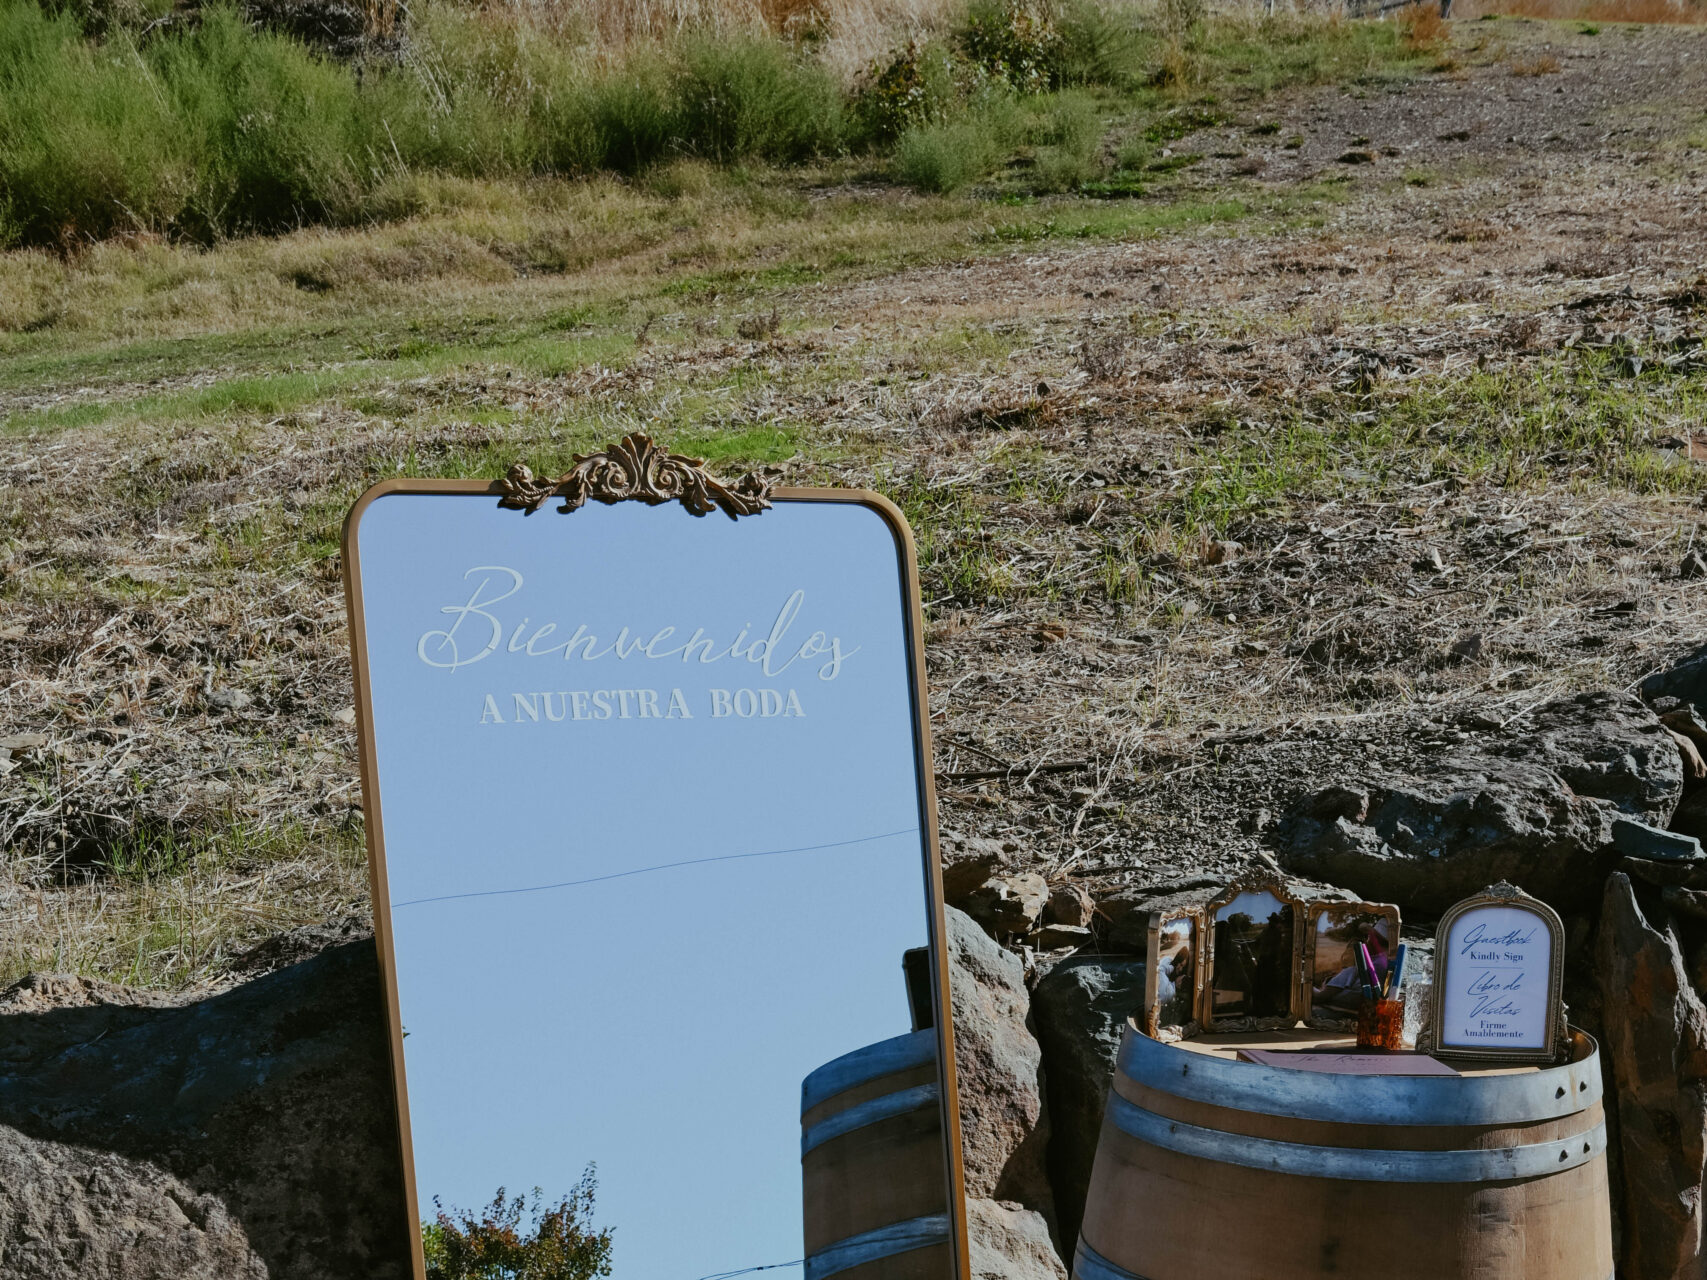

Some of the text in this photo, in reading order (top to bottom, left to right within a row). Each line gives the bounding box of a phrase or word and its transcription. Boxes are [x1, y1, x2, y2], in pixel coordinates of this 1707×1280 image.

[416, 565, 862, 681] Bienvenidos
[479, 688, 807, 724] A NUESTRA BODA
[1461, 923, 1538, 955] Guestbook
[1470, 951, 1524, 963] Kindly Sign
[1467, 970, 1525, 996] Libro de
[1470, 994, 1521, 1018] Visitas
[1464, 1028, 1525, 1038] Amablemente
[1480, 1019, 1508, 1029] Firme
